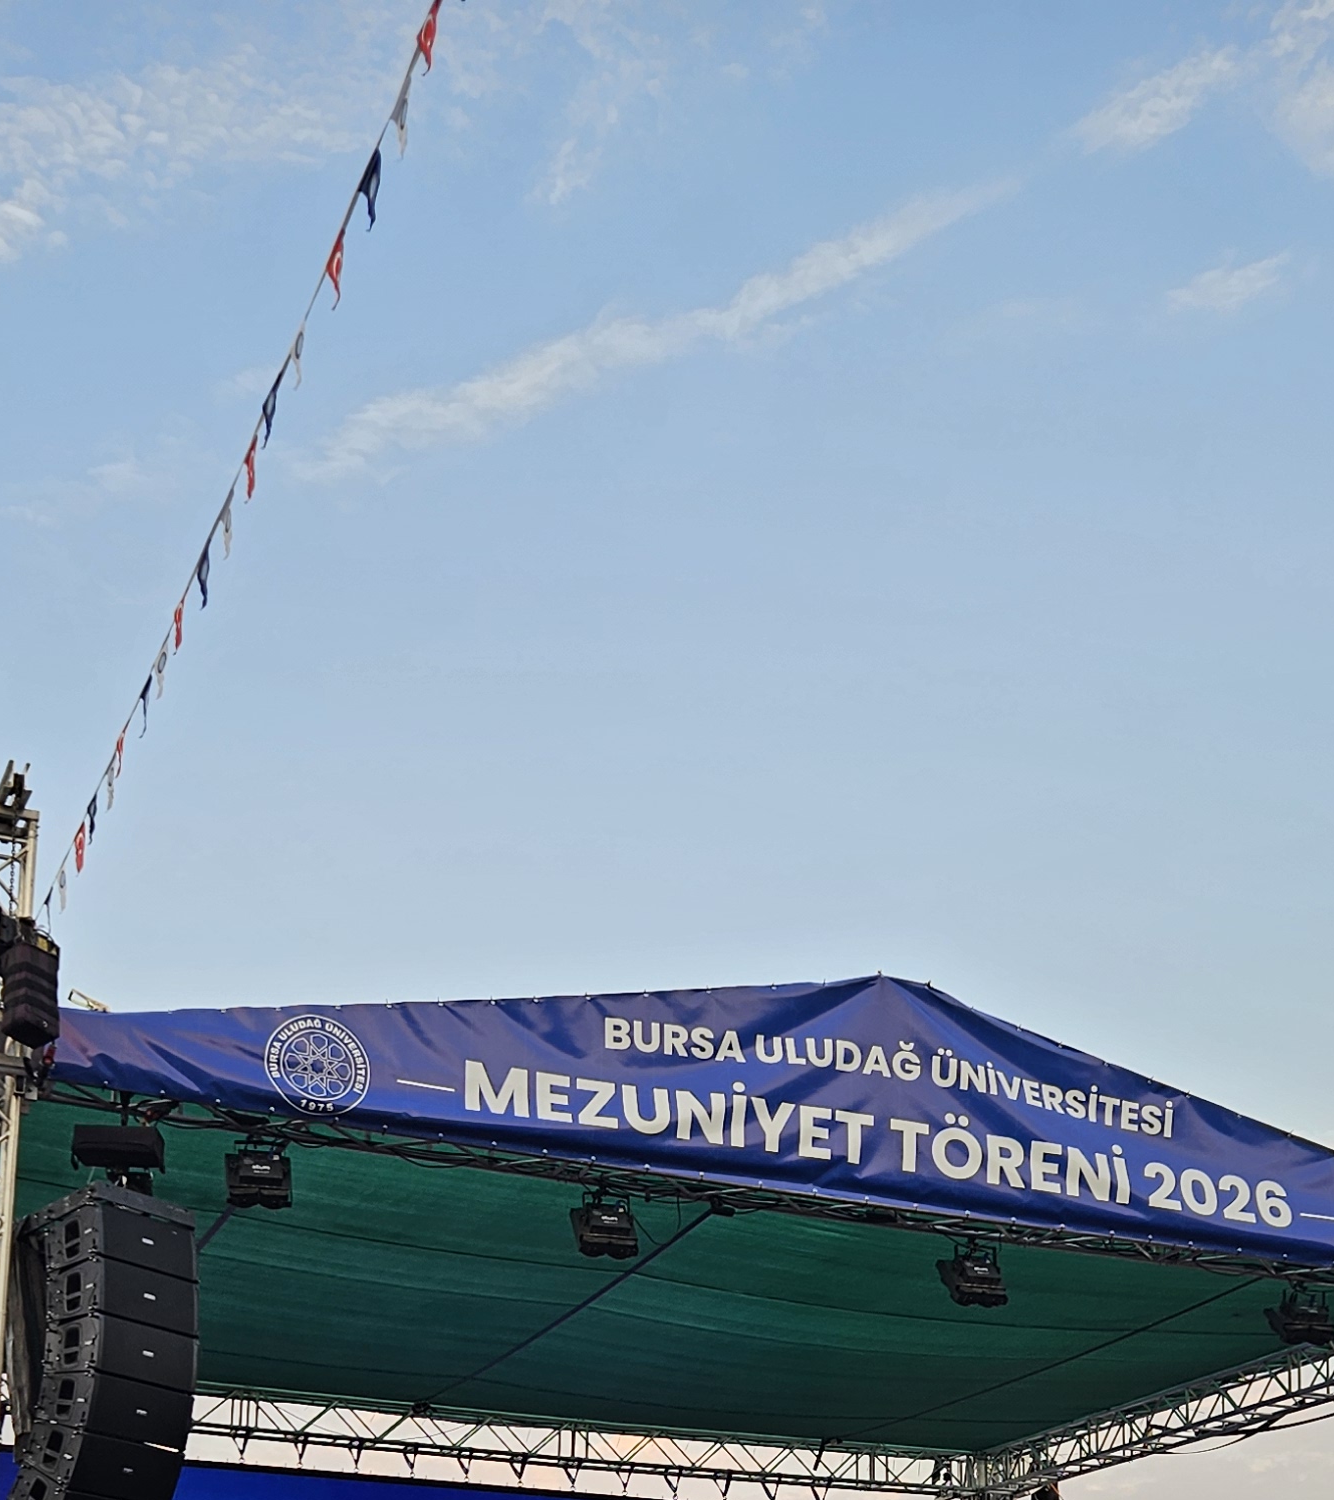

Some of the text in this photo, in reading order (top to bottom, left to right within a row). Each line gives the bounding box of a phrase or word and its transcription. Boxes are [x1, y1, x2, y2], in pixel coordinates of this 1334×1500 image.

[269, 1041, 282, 1078] BURSA
[278, 1018, 322, 1041] ULUDAĞ
[604, 1017, 1174, 1138] BURSA ULUDAĞ ÜNİVERSİTESİ
[300, 1099, 334, 1112] 1975
[464, 1059, 1294, 1228] MEZUNİYET TÖRENİ 2026
